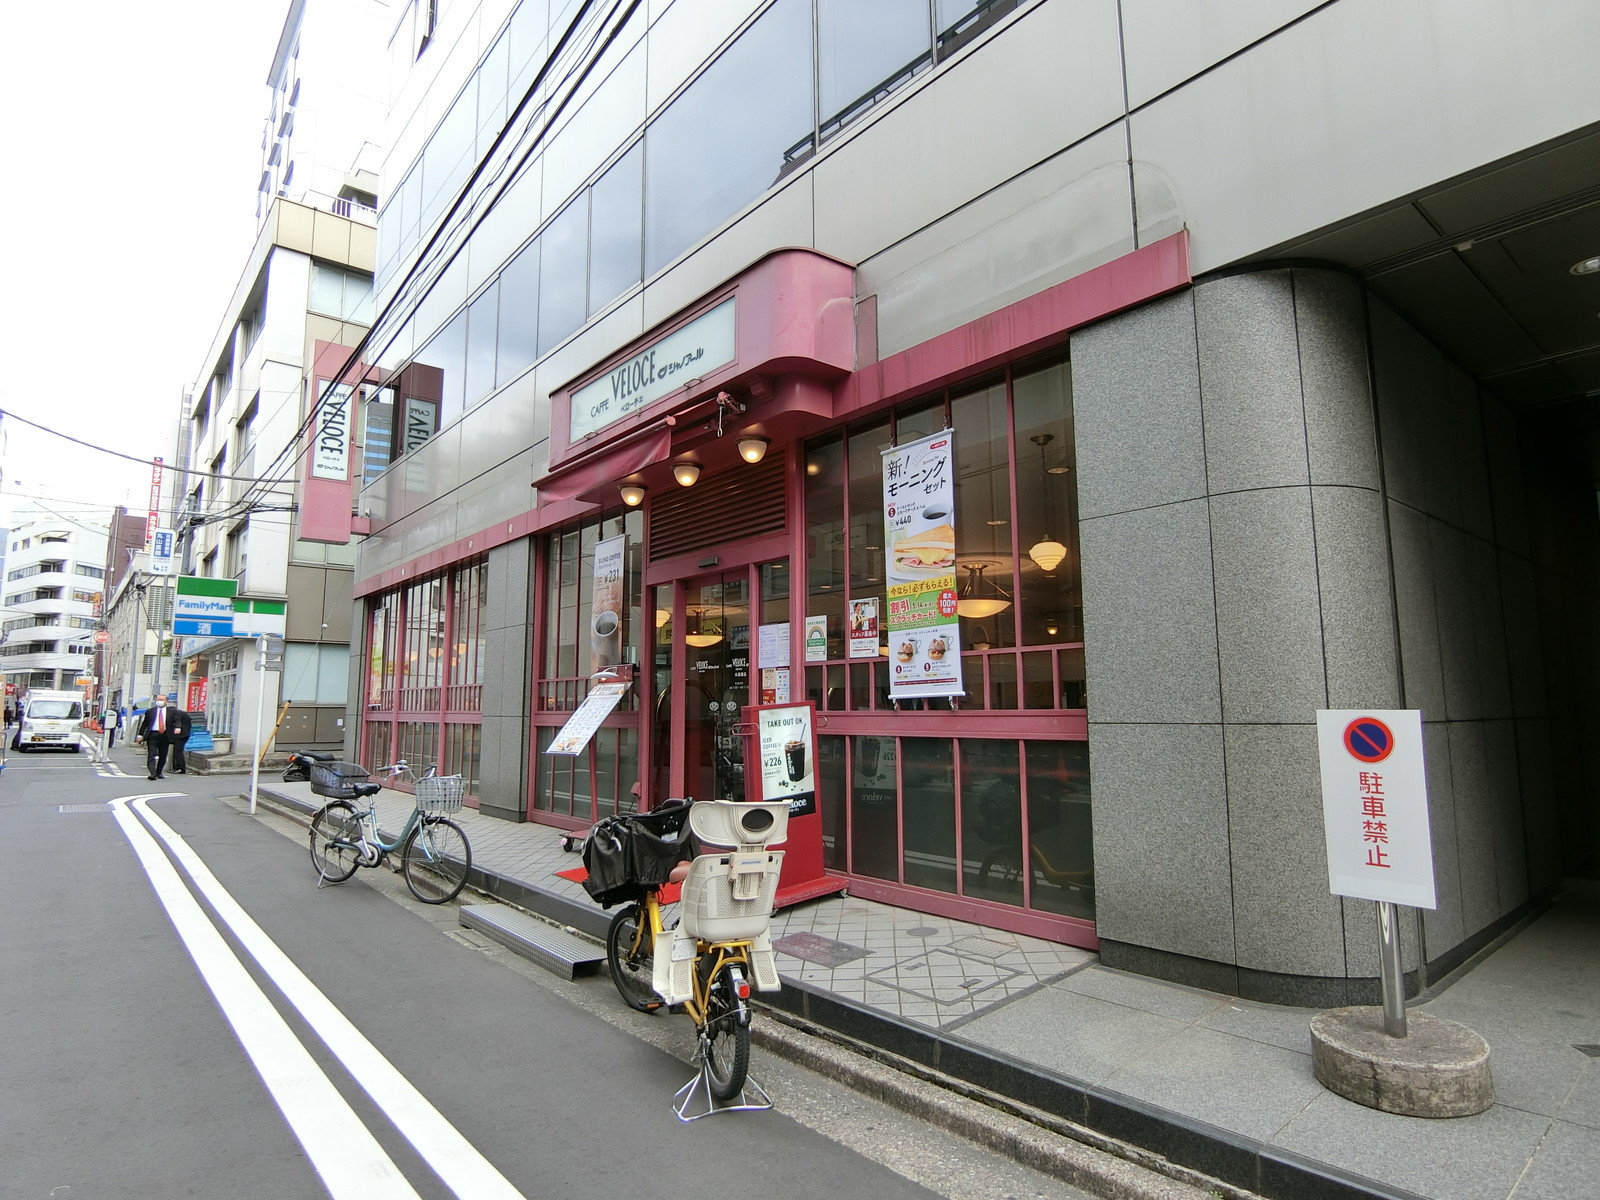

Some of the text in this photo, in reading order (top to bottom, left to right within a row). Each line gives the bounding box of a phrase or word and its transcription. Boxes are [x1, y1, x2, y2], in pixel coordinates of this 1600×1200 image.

[668, 346, 705, 375] シャノアール
[590, 350, 656, 419] CAFFE VELOCE
[620, 395, 643, 413] ベローチェ
[320, 402, 346, 455] VELOCE
[887, 456, 947, 497] モーニング
[923, 477, 947, 495] セット
[895, 515, 912, 526] ¥440
[604, 568, 619, 584] ¥231
[178, 599, 234, 612] FamilyMart
[890, 597, 911, 616] 割引
[197, 622, 212, 635] 酒
[767, 717, 803, 728] TAKE OUT OK
[764, 756, 782, 768] ¥226
[789, 798, 808, 809] loce
[1358, 771, 1391, 869] 駐車禁止
